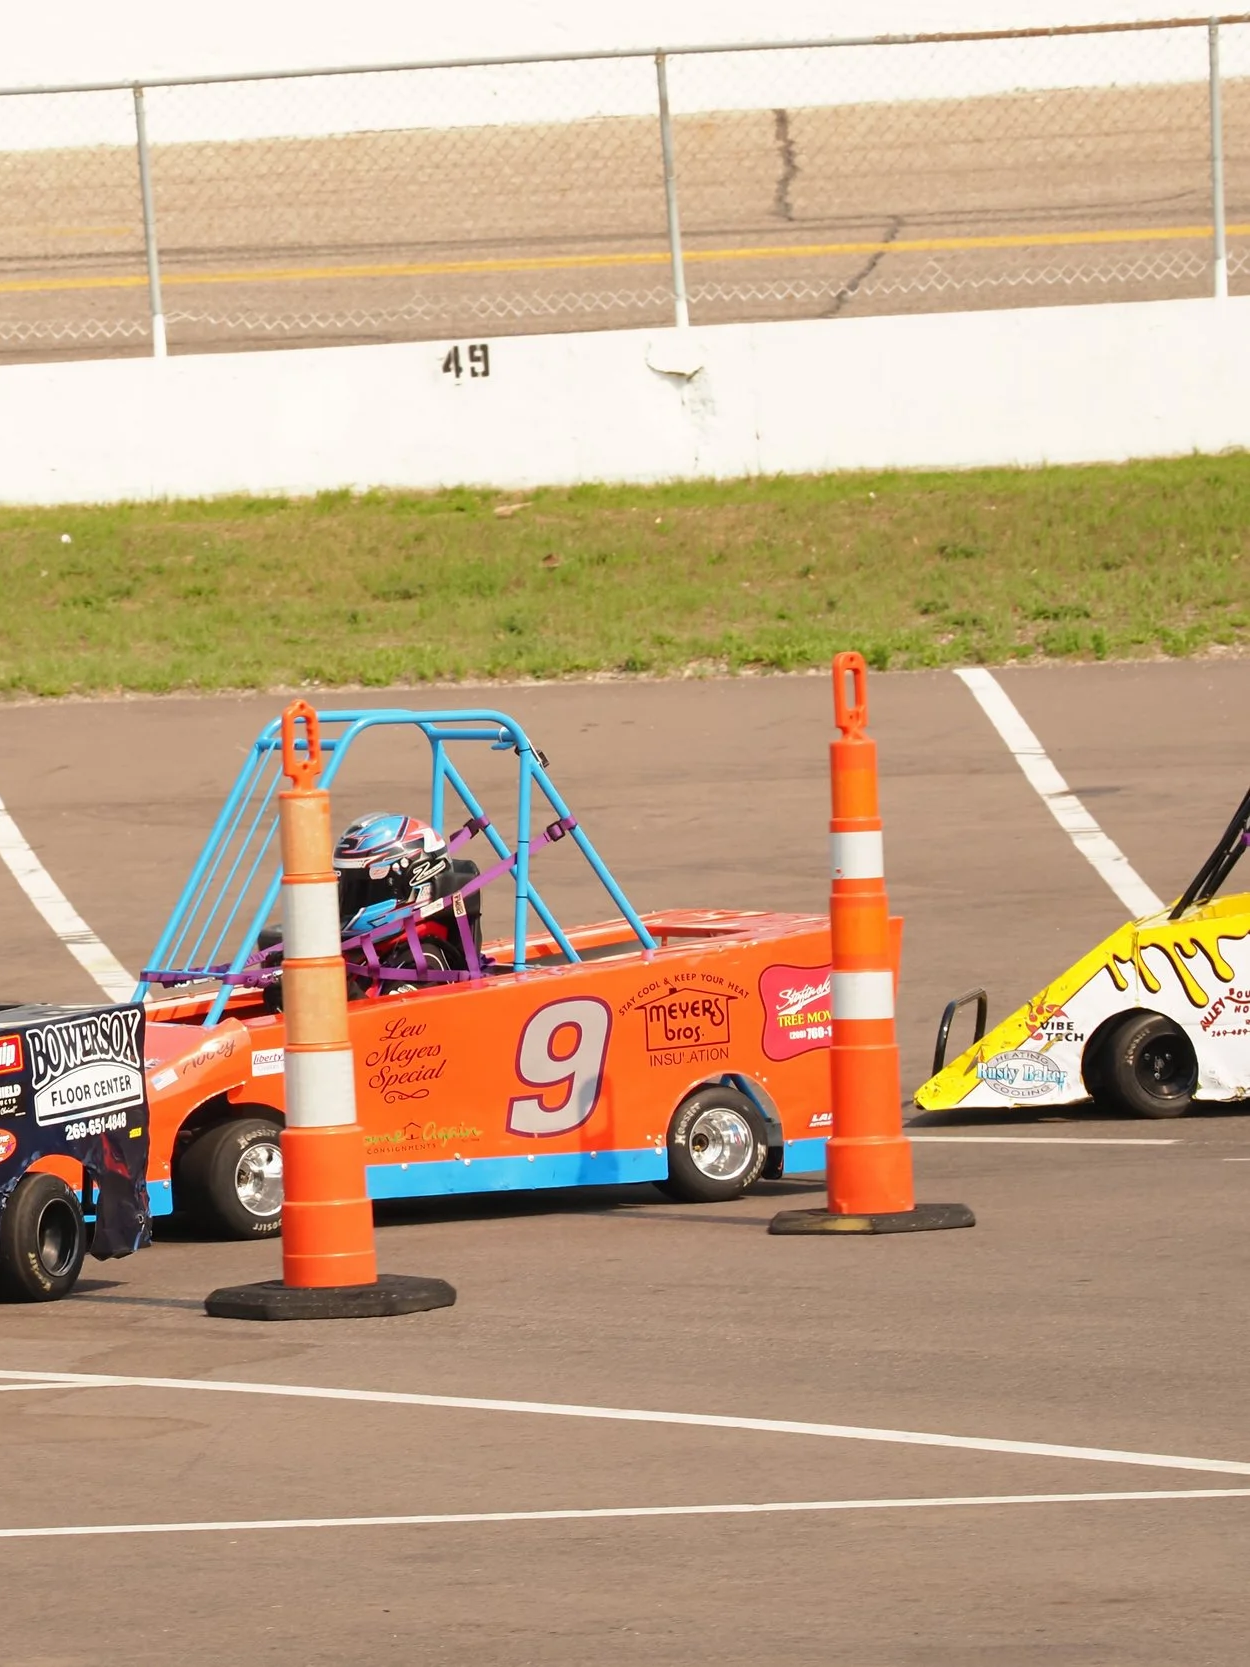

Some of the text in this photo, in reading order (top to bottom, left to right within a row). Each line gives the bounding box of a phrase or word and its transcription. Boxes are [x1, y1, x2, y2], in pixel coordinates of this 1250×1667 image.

[442, 344, 489, 378] 49
[618, 973, 750, 1016] STAY COOL & KEEP YOUR HEAT
[649, 998, 725, 1027] MEYERS
[777, 1010, 831, 1027] TREE MOV
[1040, 1022, 1075, 1031] VIBE
[1200, 997, 1226, 1032] ALLEY
[379, 1017, 427, 1041] Lew
[1045, 1033, 1084, 1042] TECH
[26, 1009, 141, 1089] BOWERSOX
[365, 1040, 441, 1068] Meyers
[995, 1051, 1050, 1065] HEATING
[369, 1059, 447, 1094] Special
[505, 995, 613, 1138] 9
[976, 1062, 1068, 1085] Rusty Baker
[51, 1075, 132, 1107] FLOOR CENTER
[993, 1083, 1050, 1097] COOLING
[65, 1112, 126, 1140] 269-651-4848
[366, 1143, 437, 1155] CONSIGNMENTS
